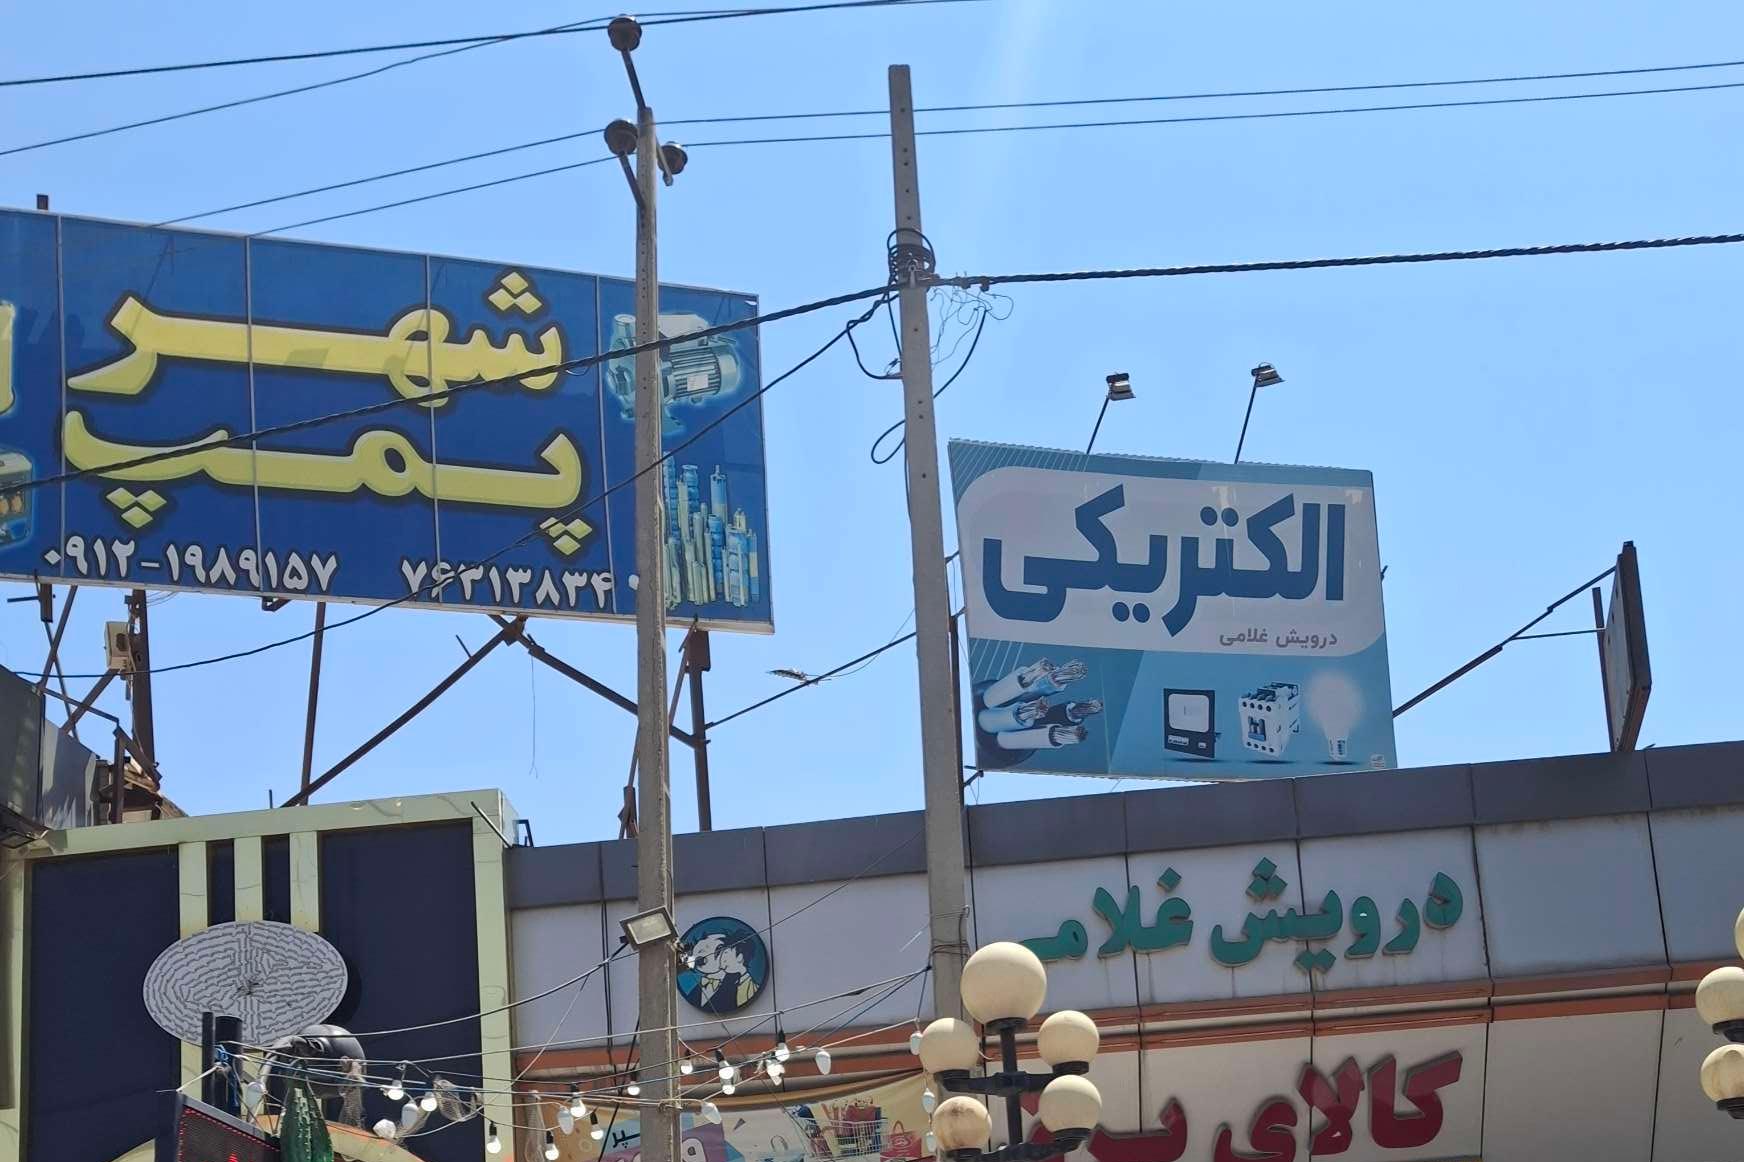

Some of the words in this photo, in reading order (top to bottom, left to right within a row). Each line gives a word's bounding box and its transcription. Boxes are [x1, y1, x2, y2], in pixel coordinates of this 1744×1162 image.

[67, 272, 563, 408] شهر
[64, 410, 593, 556] پمپ
[982, 484, 1346, 637] الکتریکی
[1219, 627, 1269, 647] غلامی
[1276, 628, 1338, 650] درویش
[1018, 866, 1194, 962] غلام
[1210, 857, 1465, 974] درویش
